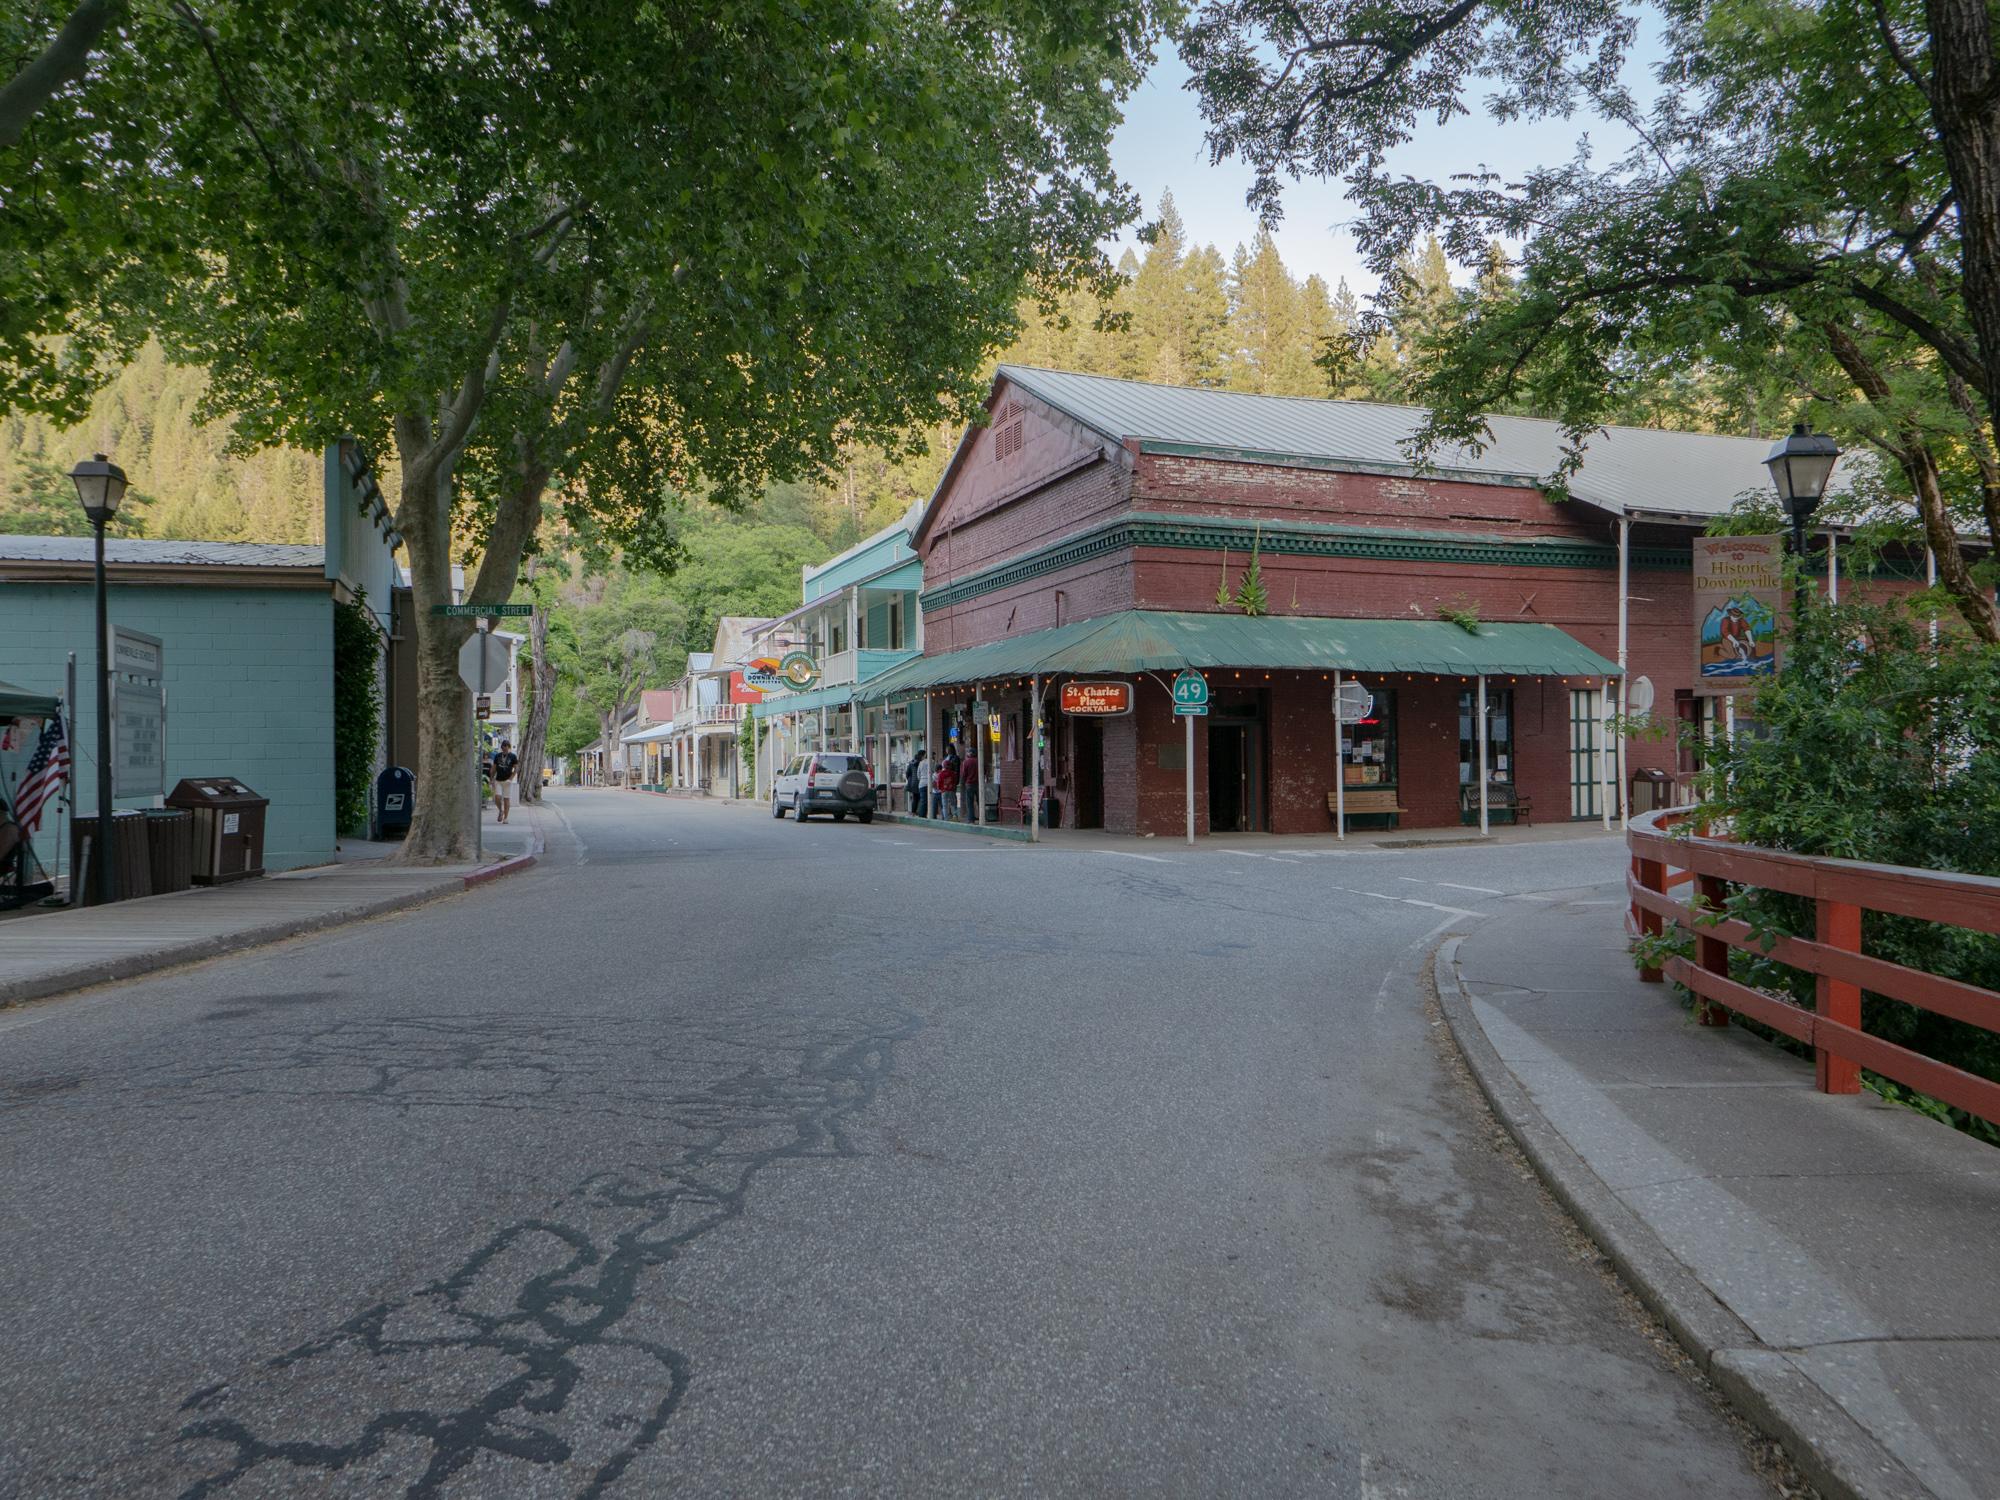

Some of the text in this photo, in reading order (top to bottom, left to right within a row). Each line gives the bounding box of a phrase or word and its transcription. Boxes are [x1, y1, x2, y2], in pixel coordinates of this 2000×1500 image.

[1732, 552, 1744, 560] to
[1711, 561, 1769, 574] Historic
[1696, 574, 1778, 589] Downieville
[446, 606, 530, 616] COMMERCIAL STREET
[1066, 686, 1120, 697] St. Charles
[1177, 683, 1201, 699] 49
[1080, 696, 1105, 706] Place
